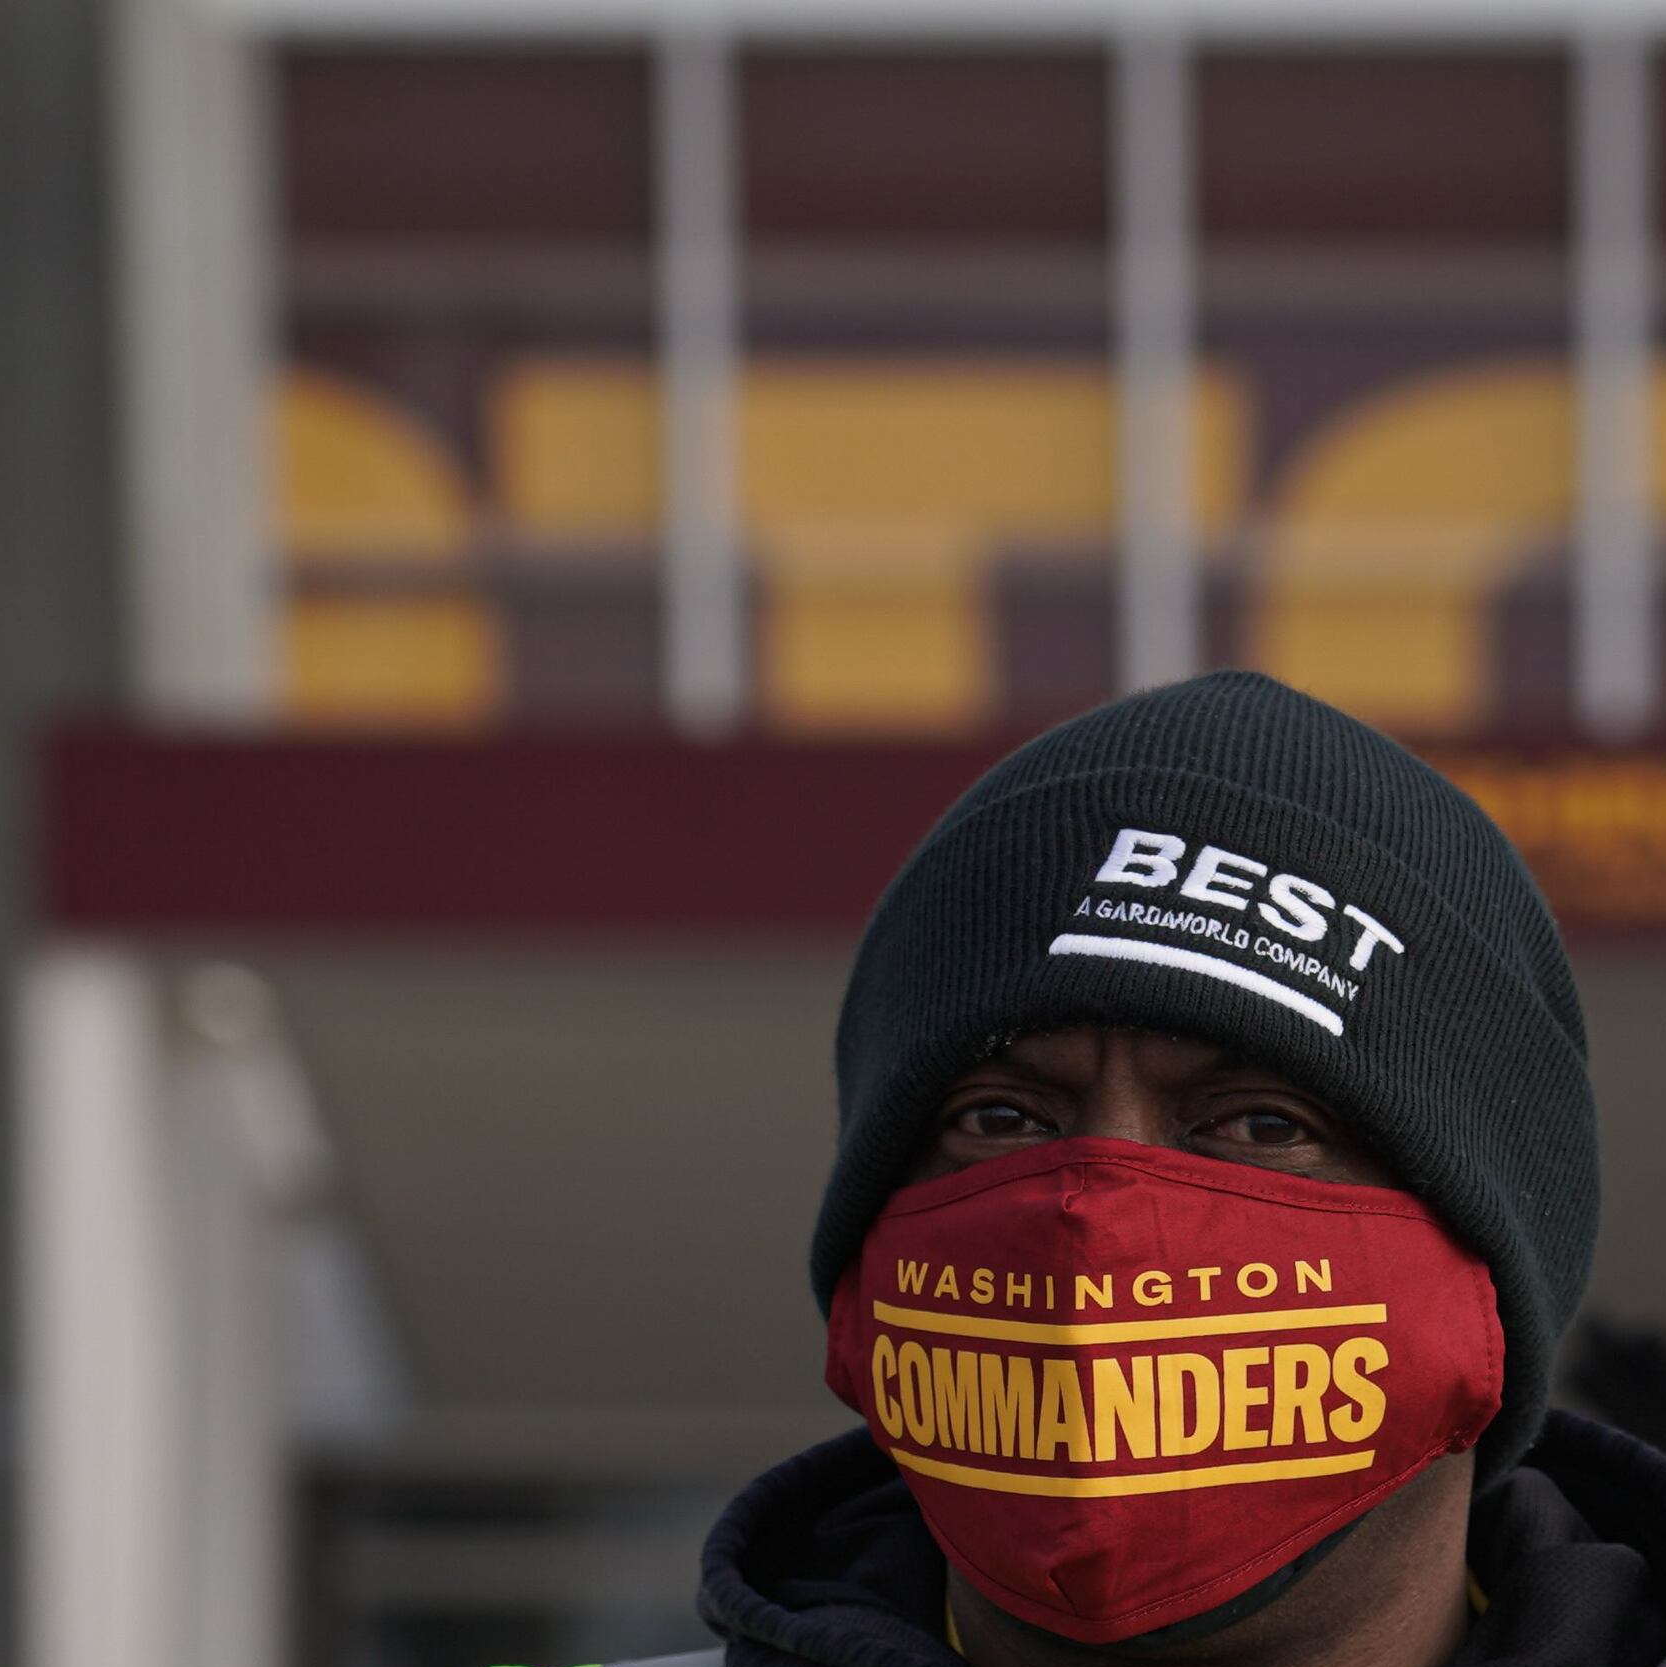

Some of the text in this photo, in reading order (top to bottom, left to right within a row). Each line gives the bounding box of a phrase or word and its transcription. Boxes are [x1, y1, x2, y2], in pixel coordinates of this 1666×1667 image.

[1074, 895, 1361, 1003] A GARDAWORLD COMPANY
[1093, 827, 1405, 972] BEST
[895, 1258, 1334, 1312] WASHINGTON
[871, 1335, 1390, 1464] COMMANDERS
